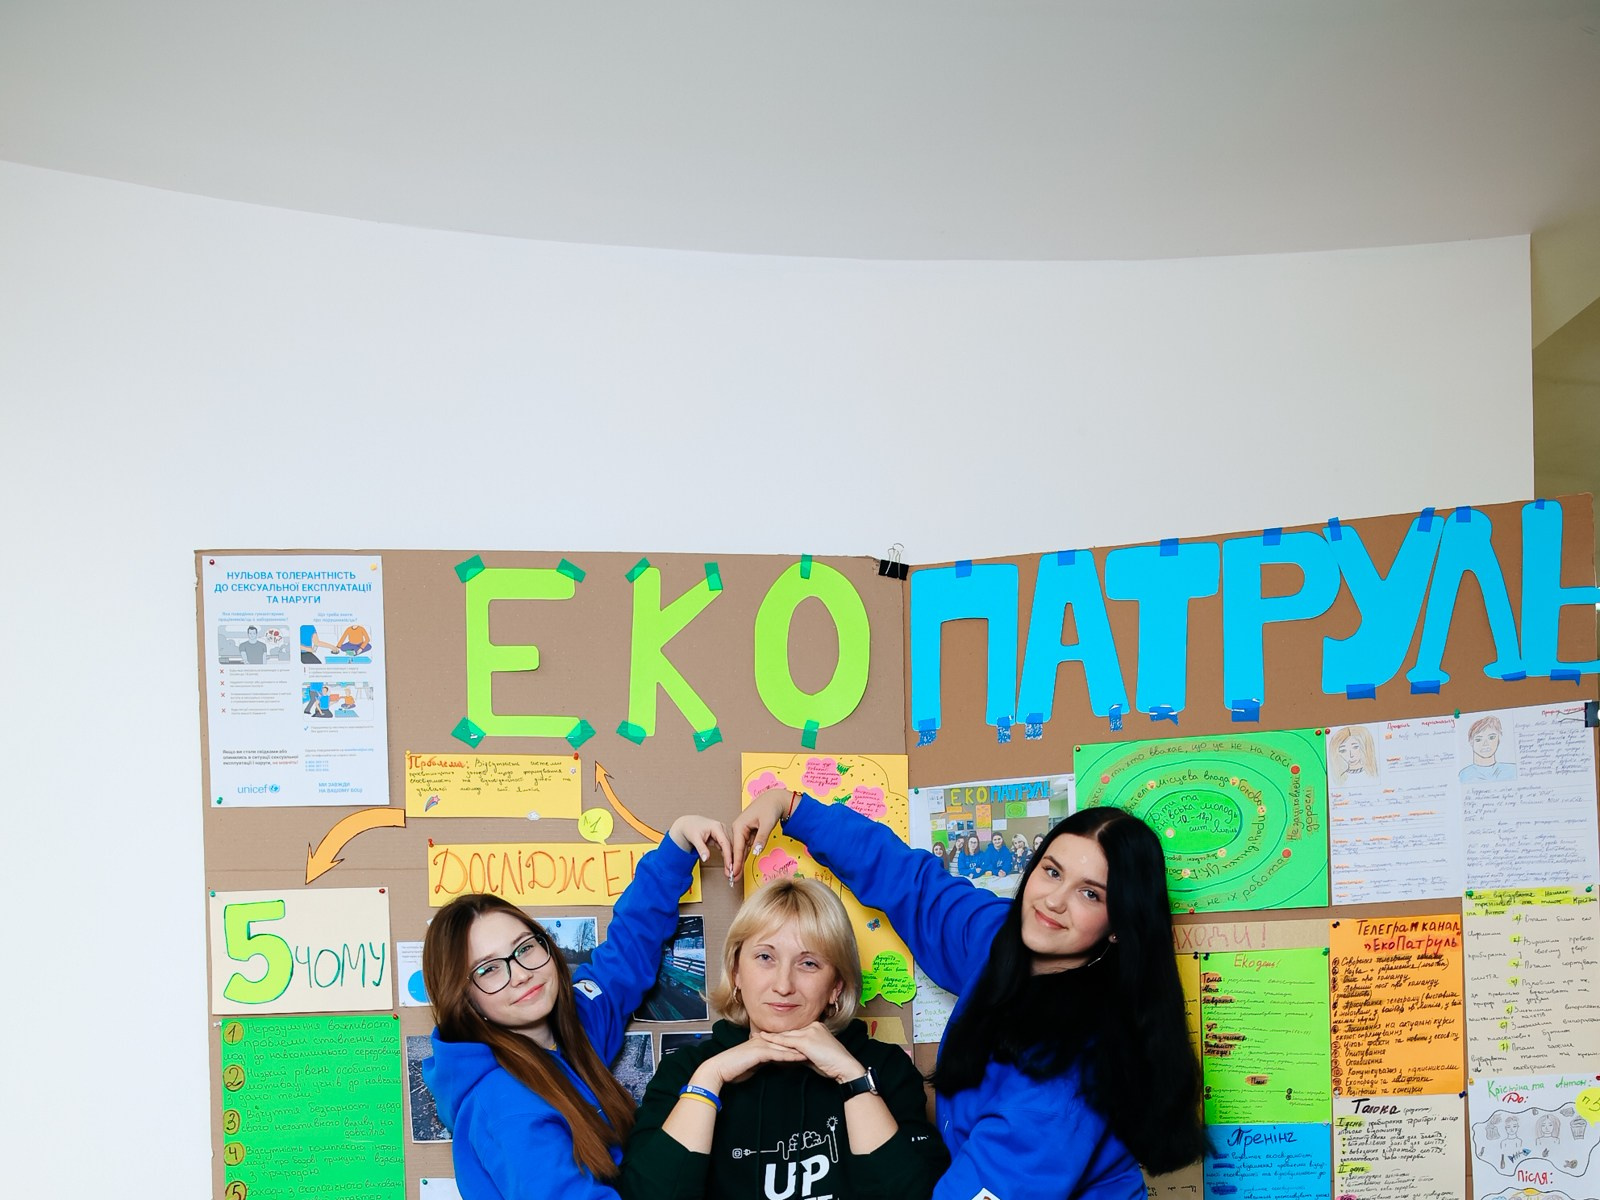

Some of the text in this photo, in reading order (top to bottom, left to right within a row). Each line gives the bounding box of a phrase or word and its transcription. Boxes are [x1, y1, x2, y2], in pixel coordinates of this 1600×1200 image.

[227, 571, 356, 581] НУЛЬОВА ТОЛЕРАНТНІСТЬ
[214, 582, 372, 594] ДО СЕКСУАЛЬНОЇ ЕКСПЛУАТАЦІЇ
[266, 596, 321, 604] ТА НАРУГИ
[466, 500, 1600, 738] ЕКО ПАТРУЛЬ
[1231, 742, 1242, 751] не
[1250, 745, 1264, 755] на
[409, 756, 469, 772] Проблема:
[1156, 769, 1199, 789] Місцева
[1203, 769, 1230, 788] влада
[237, 784, 268, 794] unicef
[951, 786, 988, 805] ЕКО
[1180, 794, 1199, 802] та
[433, 848, 645, 897] ДОСЛІДЖЕ
[1242, 857, 1284, 901] робота
[1421, 921, 1460, 933] канал
[223, 899, 385, 1004] 5 ЧОМУ
[1377, 973, 1411, 983] команду
[228, 1019, 393, 1044] 1 Нерозуміння важливості
[243, 1037, 306, 1052] проблеми
[313, 1035, 374, 1045] ставлення
[253, 1053, 264, 1065] до
[269, 1048, 348, 1059] навколишнього
[226, 1067, 243, 1087] 2
[246, 1066, 287, 1082] Низький
[294, 1064, 330, 1080] рівень
[313, 1076, 341, 1093] учнів
[348, 1079, 359, 1093] до
[278, 1091, 311, 1099] теми
[226, 1112, 237, 1131] 3
[1227, 1126, 1298, 1156] Тренінг
[228, 1146, 238, 1162] 4
[1517, 1169, 1553, 1185] Після:
